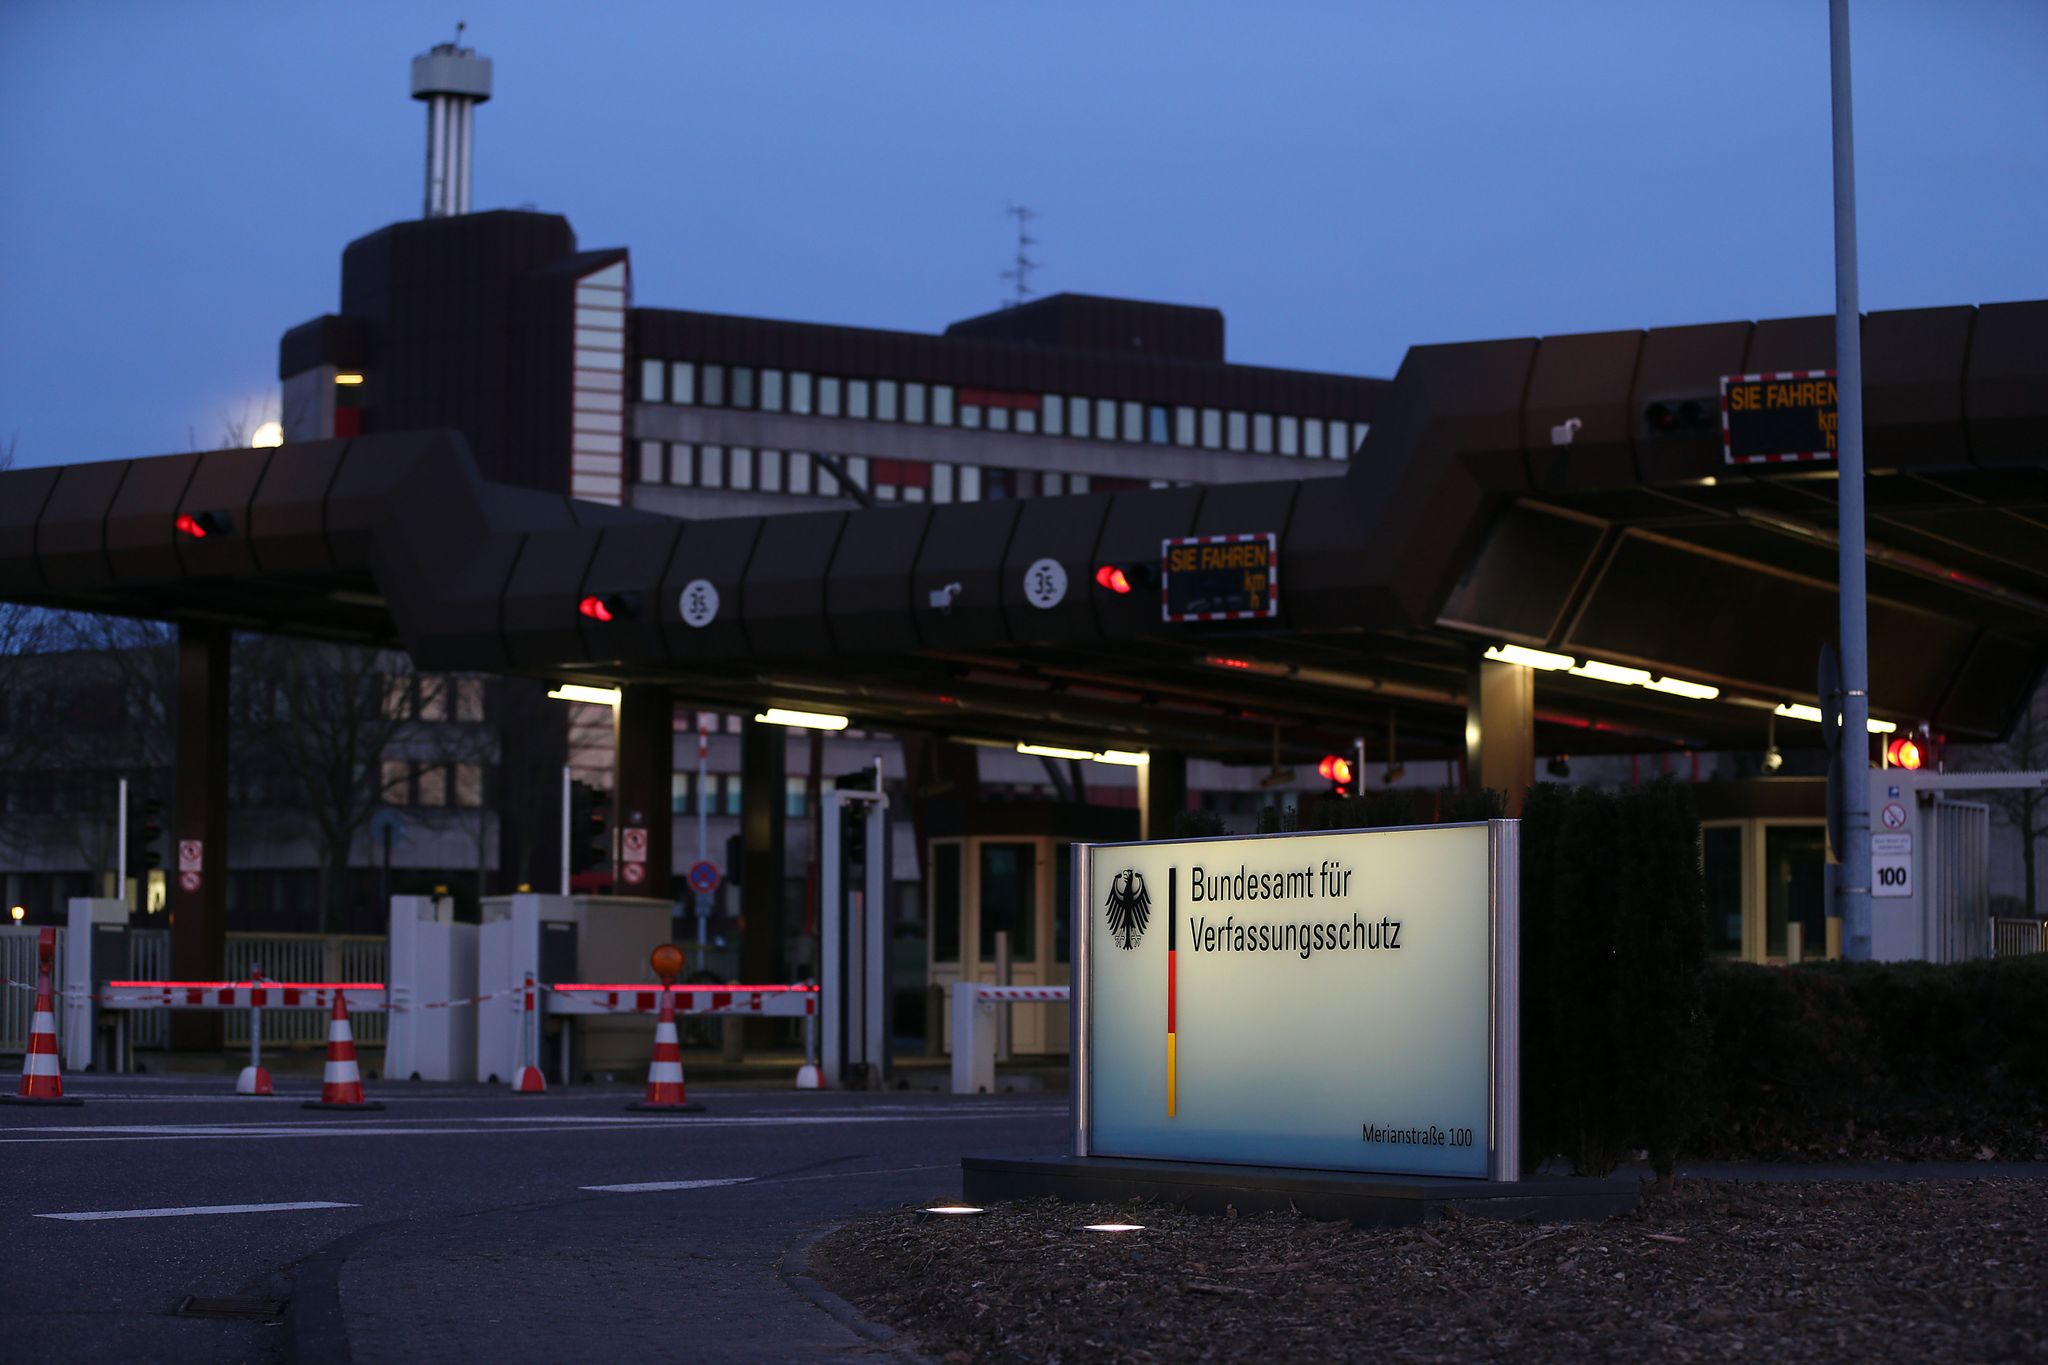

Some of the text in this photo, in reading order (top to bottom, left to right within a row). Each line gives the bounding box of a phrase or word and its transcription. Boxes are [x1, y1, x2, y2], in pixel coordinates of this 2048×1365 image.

[1731, 381, 1838, 411] SIE FAHREN
[1170, 544, 1266, 572] SIE FAHREN
[1191, 860, 1352, 902] Bundesamt für
[1877, 867, 1907, 886] 100
[1190, 912, 1401, 959] Verfassungsschutz
[1362, 1123, 1473, 1147] Merianstraße 100
